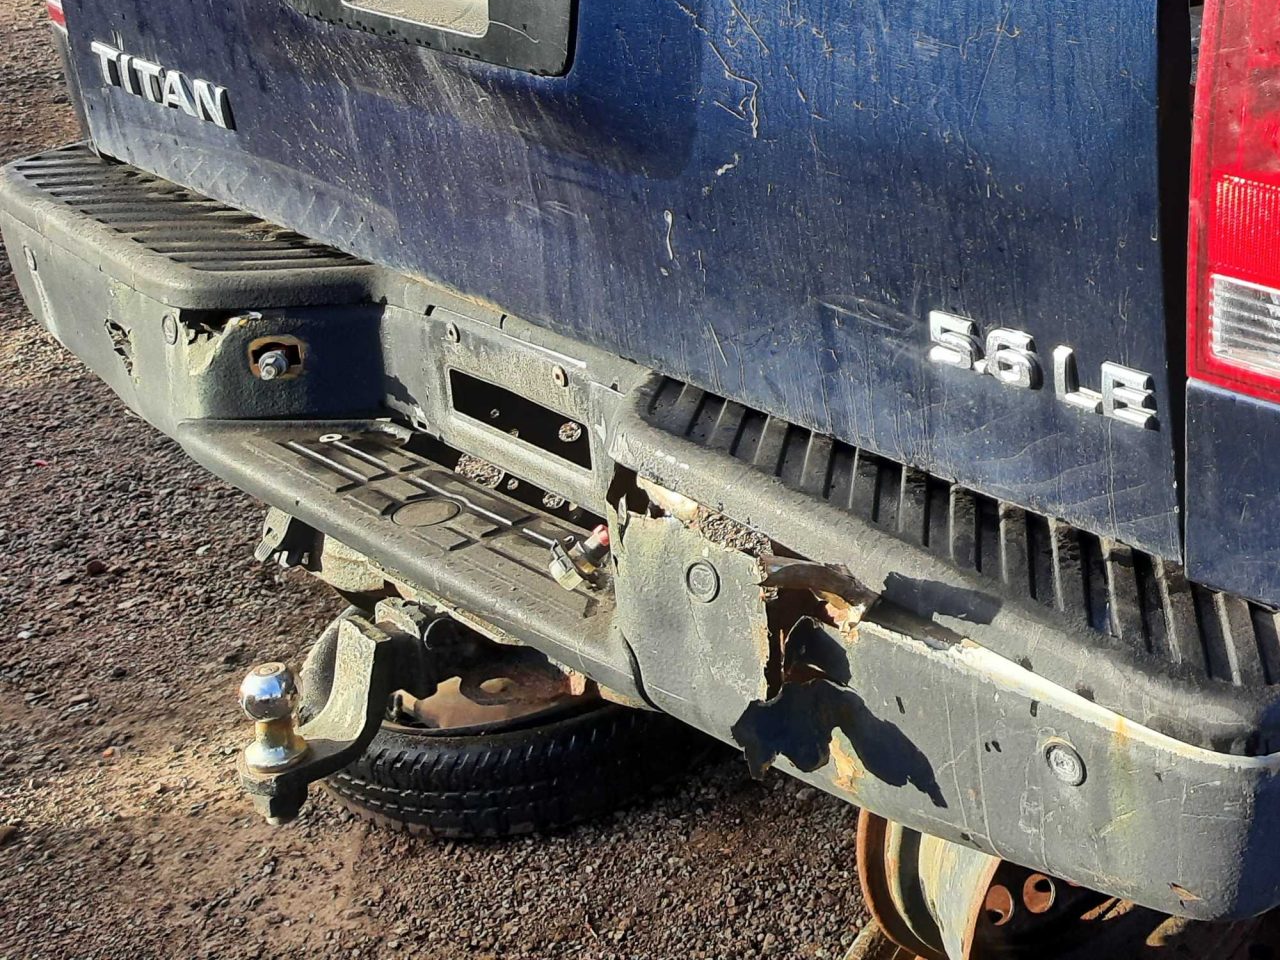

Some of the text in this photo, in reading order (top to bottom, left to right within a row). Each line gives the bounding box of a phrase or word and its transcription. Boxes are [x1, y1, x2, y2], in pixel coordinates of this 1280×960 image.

[90, 40, 236, 131] TITAN
[929, 309, 1161, 432] 5.6 LE
